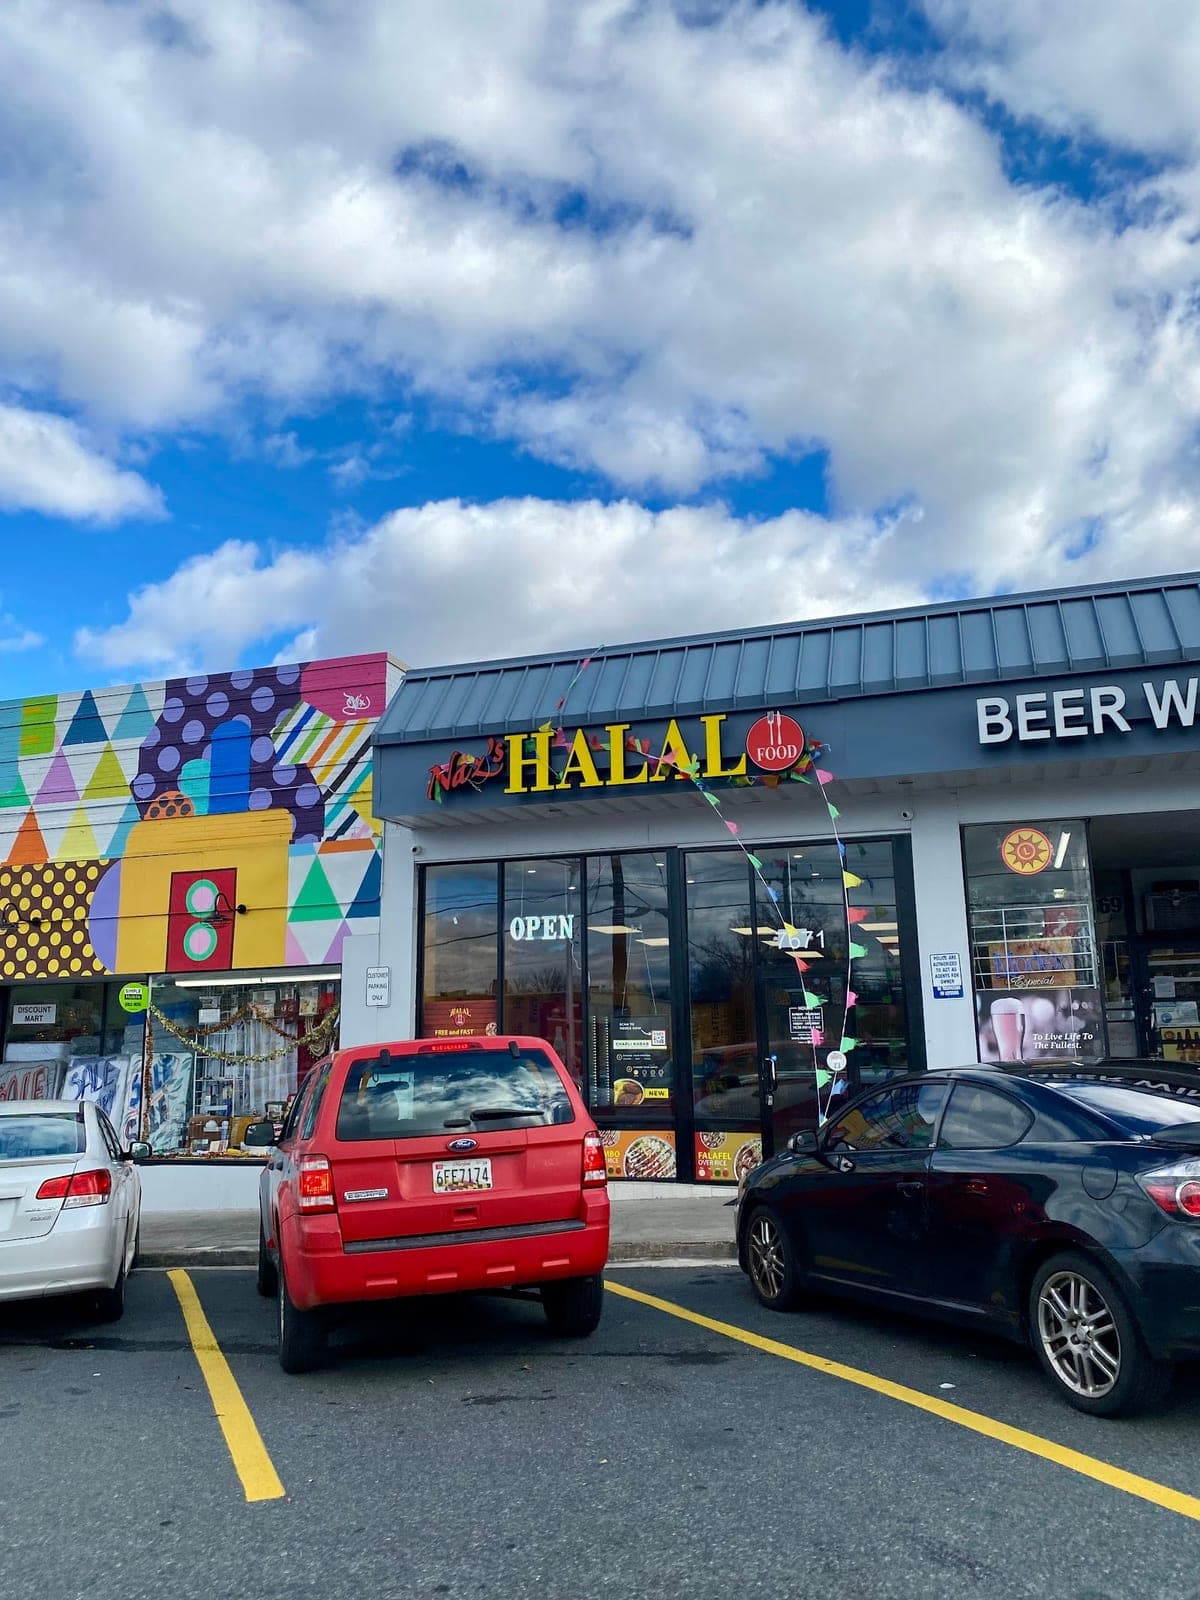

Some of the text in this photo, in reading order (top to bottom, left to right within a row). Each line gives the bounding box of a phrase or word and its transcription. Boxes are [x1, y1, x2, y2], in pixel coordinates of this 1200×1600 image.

[976, 685, 1132, 744] BEER
[426, 714, 747, 801] Naz's HALAL
[757, 744, 797, 762] FOOD
[509, 914, 575, 941] OPEN
[1010, 974, 1055, 988] Especial
[1033, 1032, 1094, 1041] To Live Life To
[1050, 1041, 1082, 1049] Fullest.
[604, 1150, 620, 1158] MBO
[697, 1151, 732, 1160] FALAFEL
[714, 1159, 728, 1167] RICE
